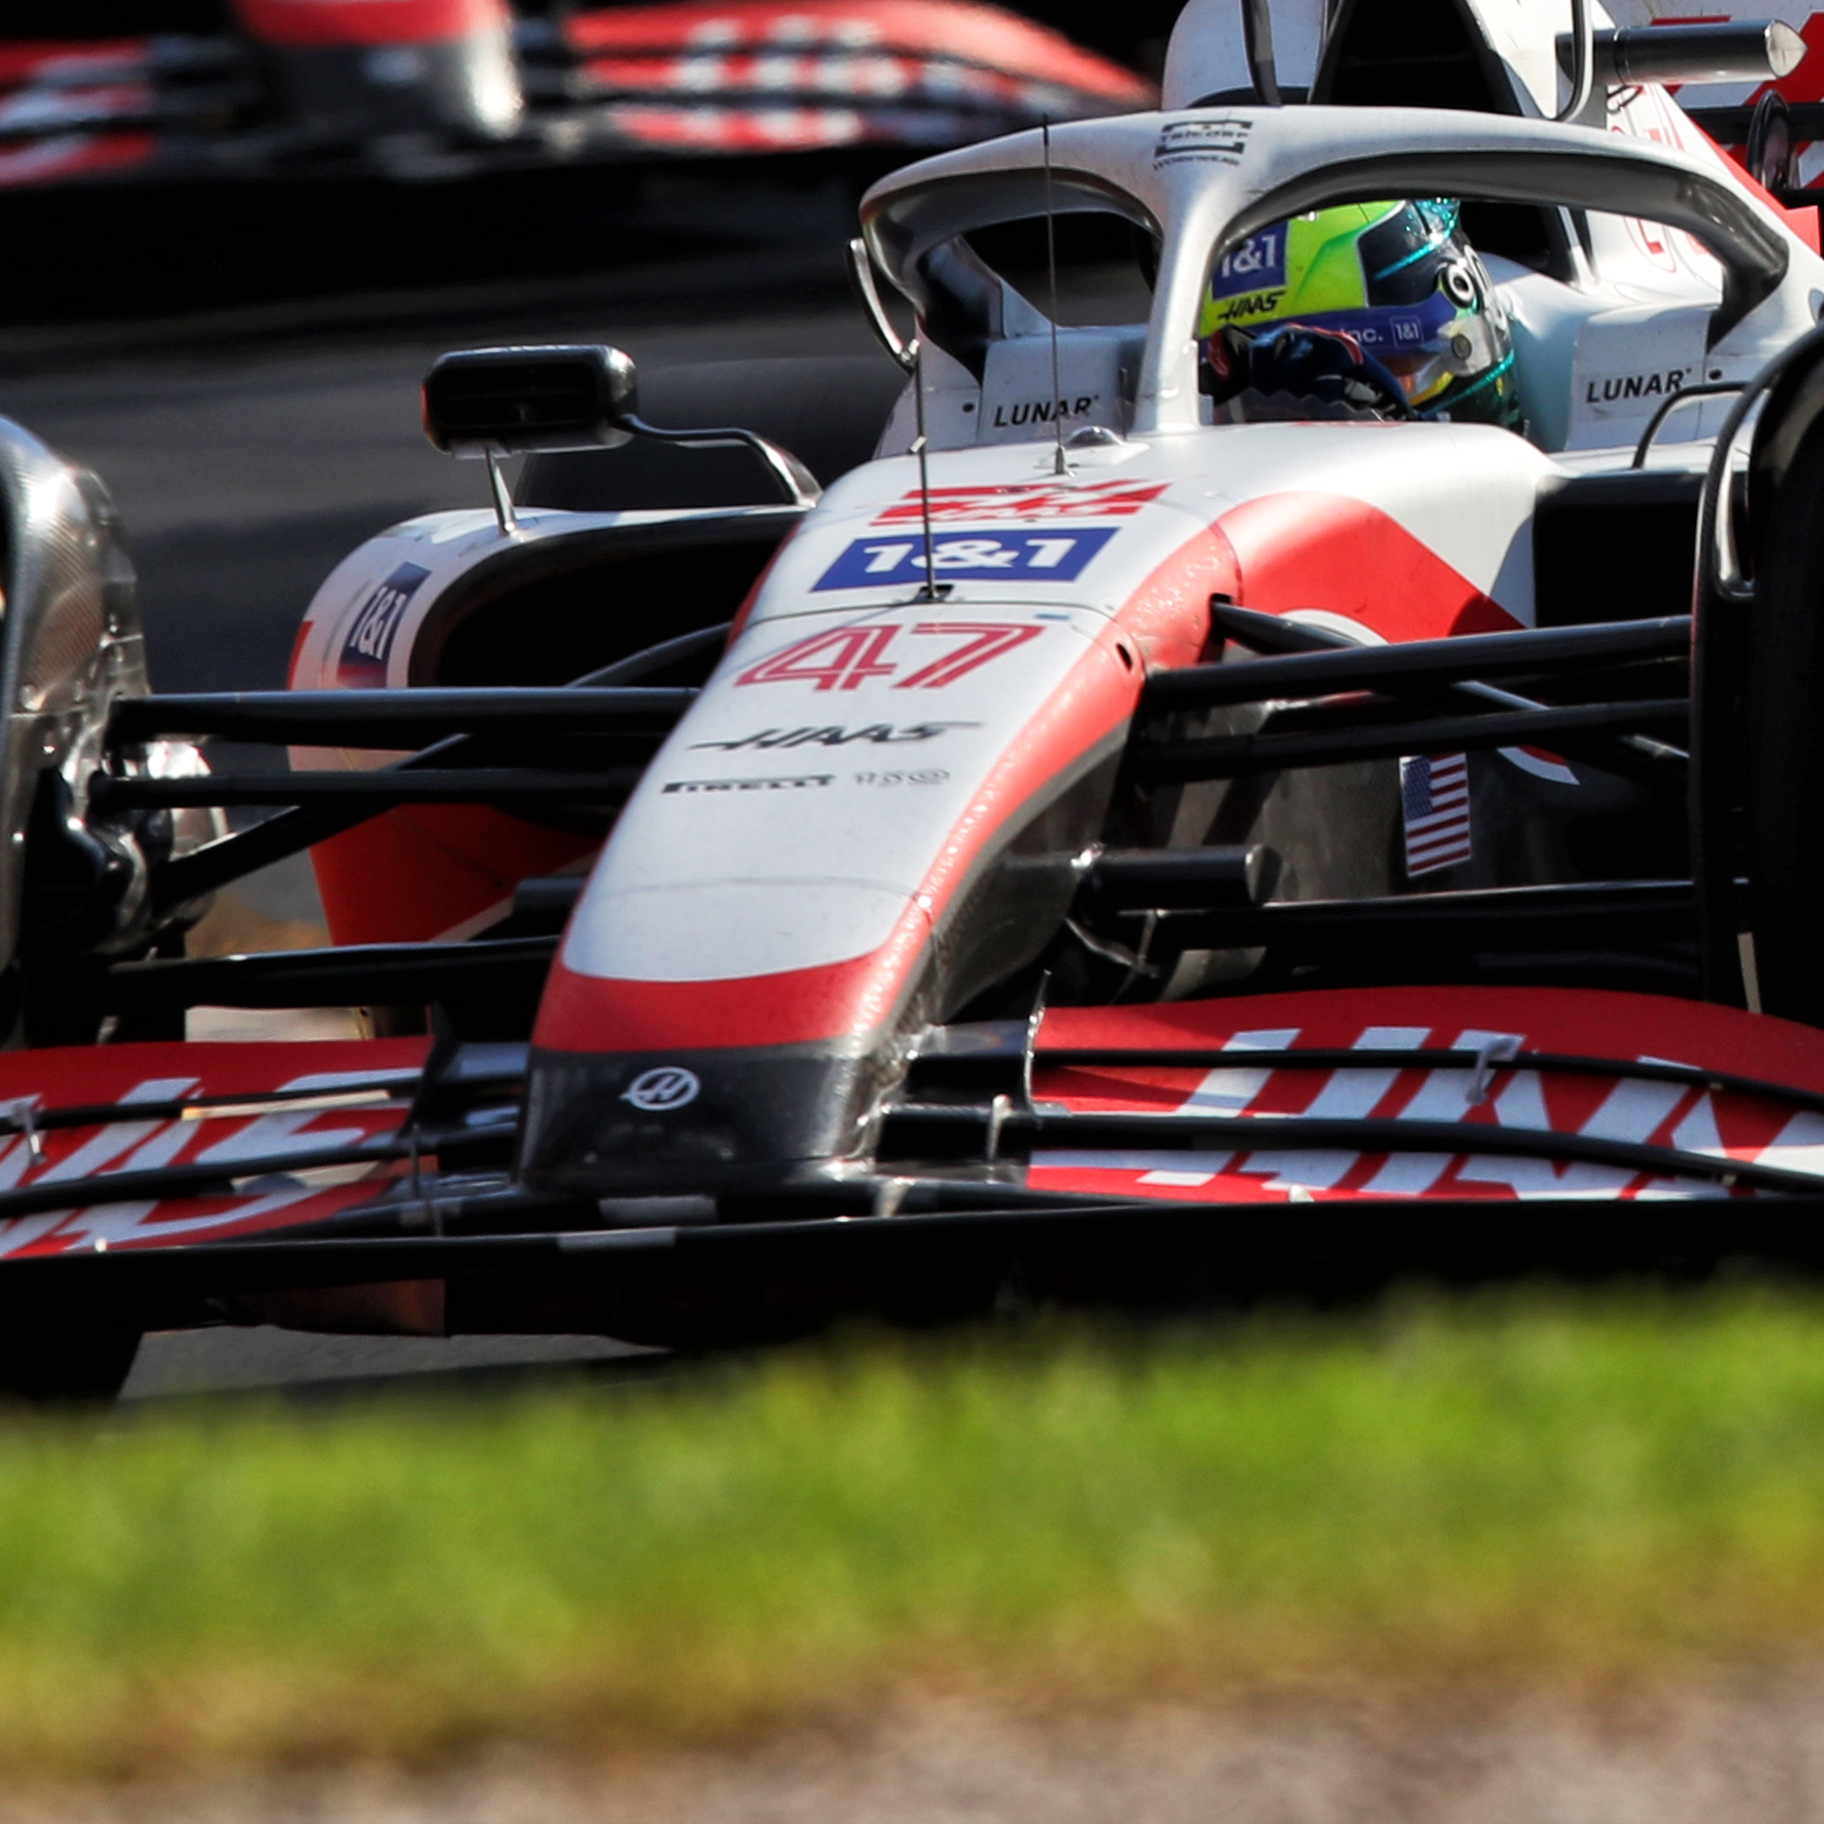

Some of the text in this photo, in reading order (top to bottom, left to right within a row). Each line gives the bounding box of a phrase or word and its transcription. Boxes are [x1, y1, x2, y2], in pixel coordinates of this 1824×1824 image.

[1217, 289, 1287, 320] HAAS
[1395, 322, 1419, 341] 1&1
[1586, 369, 1685, 404] LUNAR
[993, 397, 1093, 428] LUNAR
[863, 538, 1077, 574] 1&1
[348, 586, 407, 660] 1&1
[732, 624, 1046, 692] 47
[686, 722, 984, 750] HAAS
